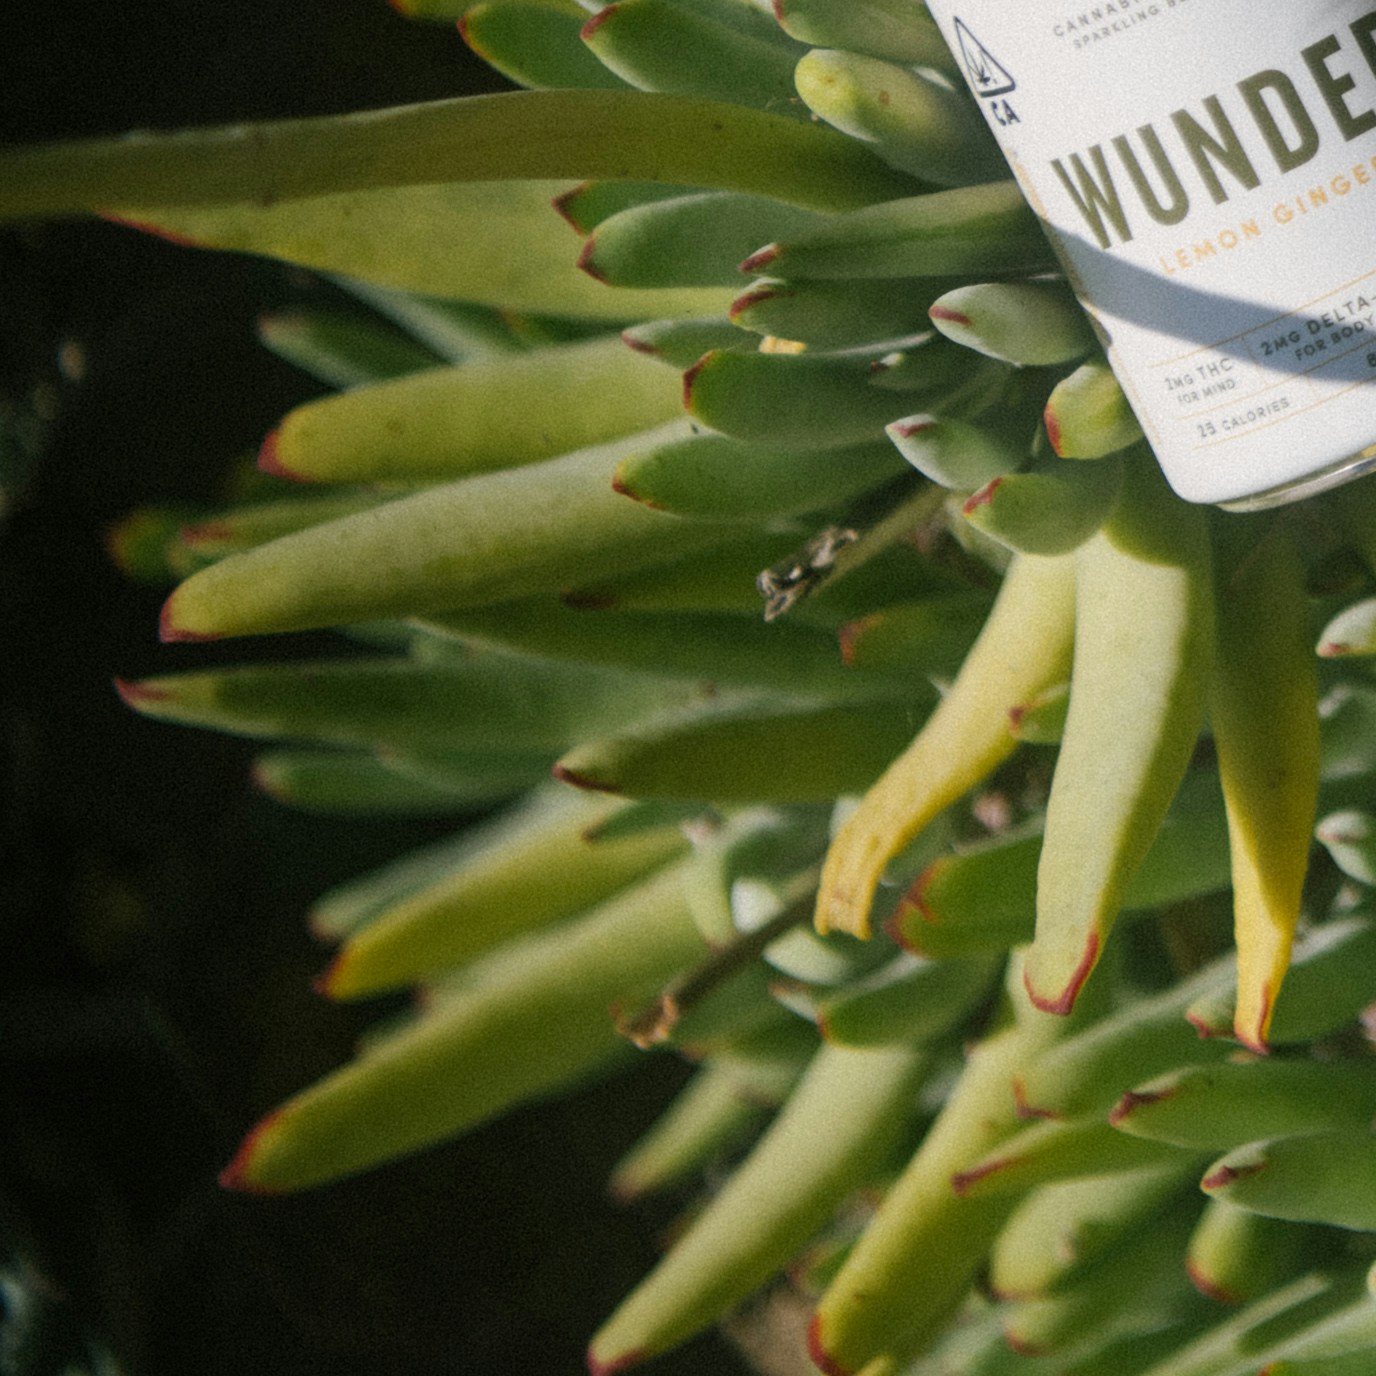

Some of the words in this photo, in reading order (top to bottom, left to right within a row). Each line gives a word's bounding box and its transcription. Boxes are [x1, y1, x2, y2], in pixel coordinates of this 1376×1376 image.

[1073, 5, 1160, 49] SPARKLING
[991, 99, 1021, 127] CA
[1159, 218, 1262, 276] LEMON
[1261, 330, 1302, 356] 2MG
[1294, 338, 1328, 362] FOR
[1331, 314, 1374, 345] BODY
[1197, 358, 1234, 380] THC
[1203, 378, 1236, 398] MIND
[1221, 397, 1290, 431] CALORIES
